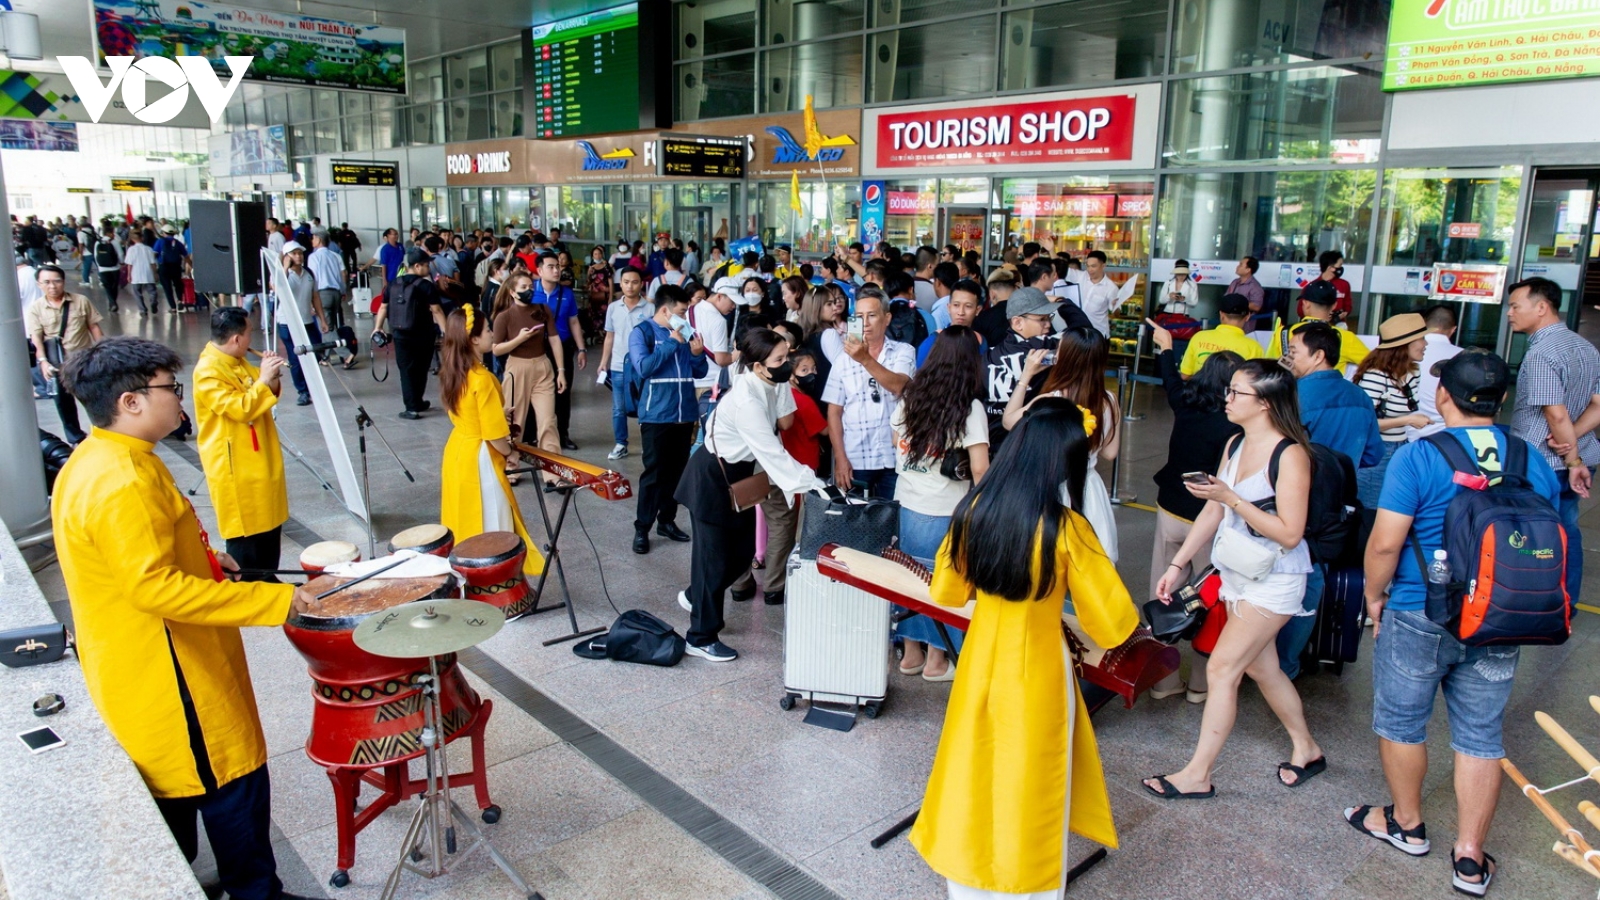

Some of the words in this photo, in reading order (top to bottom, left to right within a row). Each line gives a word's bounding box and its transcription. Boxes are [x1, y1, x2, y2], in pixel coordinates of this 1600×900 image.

[217, 12, 232, 20] ĐẾN
[300, 19, 314, 30] NÚI
[318, 21, 340, 34] THẦN
[342, 25, 356, 36] TÀI
[1263, 20, 1290, 43] ACV
[1467, 40, 1486, 49] Văn
[1489, 38, 1512, 47] Linh,
[1516, 36, 1527, 44] Q.
[1531, 34, 1548, 43] Hải
[1552, 31, 1584, 41] Châu,
[1412, 60, 1438, 70] Phạm
[1442, 58, 1460, 66] Văn
[1532, 50, 1550, 59] Trà,
[1555, 48, 1569, 57] Đà
[1424, 75, 1434, 83] Lê
[1468, 71, 1478, 79] Q.
[1482, 69, 1498, 78] Hải
[1502, 67, 1532, 77] Châu,
[1536, 65, 1551, 74] Đà
[889, 115, 1011, 150] TOURISM
[1018, 108, 1111, 145] SHOP
[447, 154, 471, 174] FOOD
[477, 151, 511, 173] DRINKS
[772, 146, 845, 164] MACO
[1457, 278, 1475, 288] CẤM
